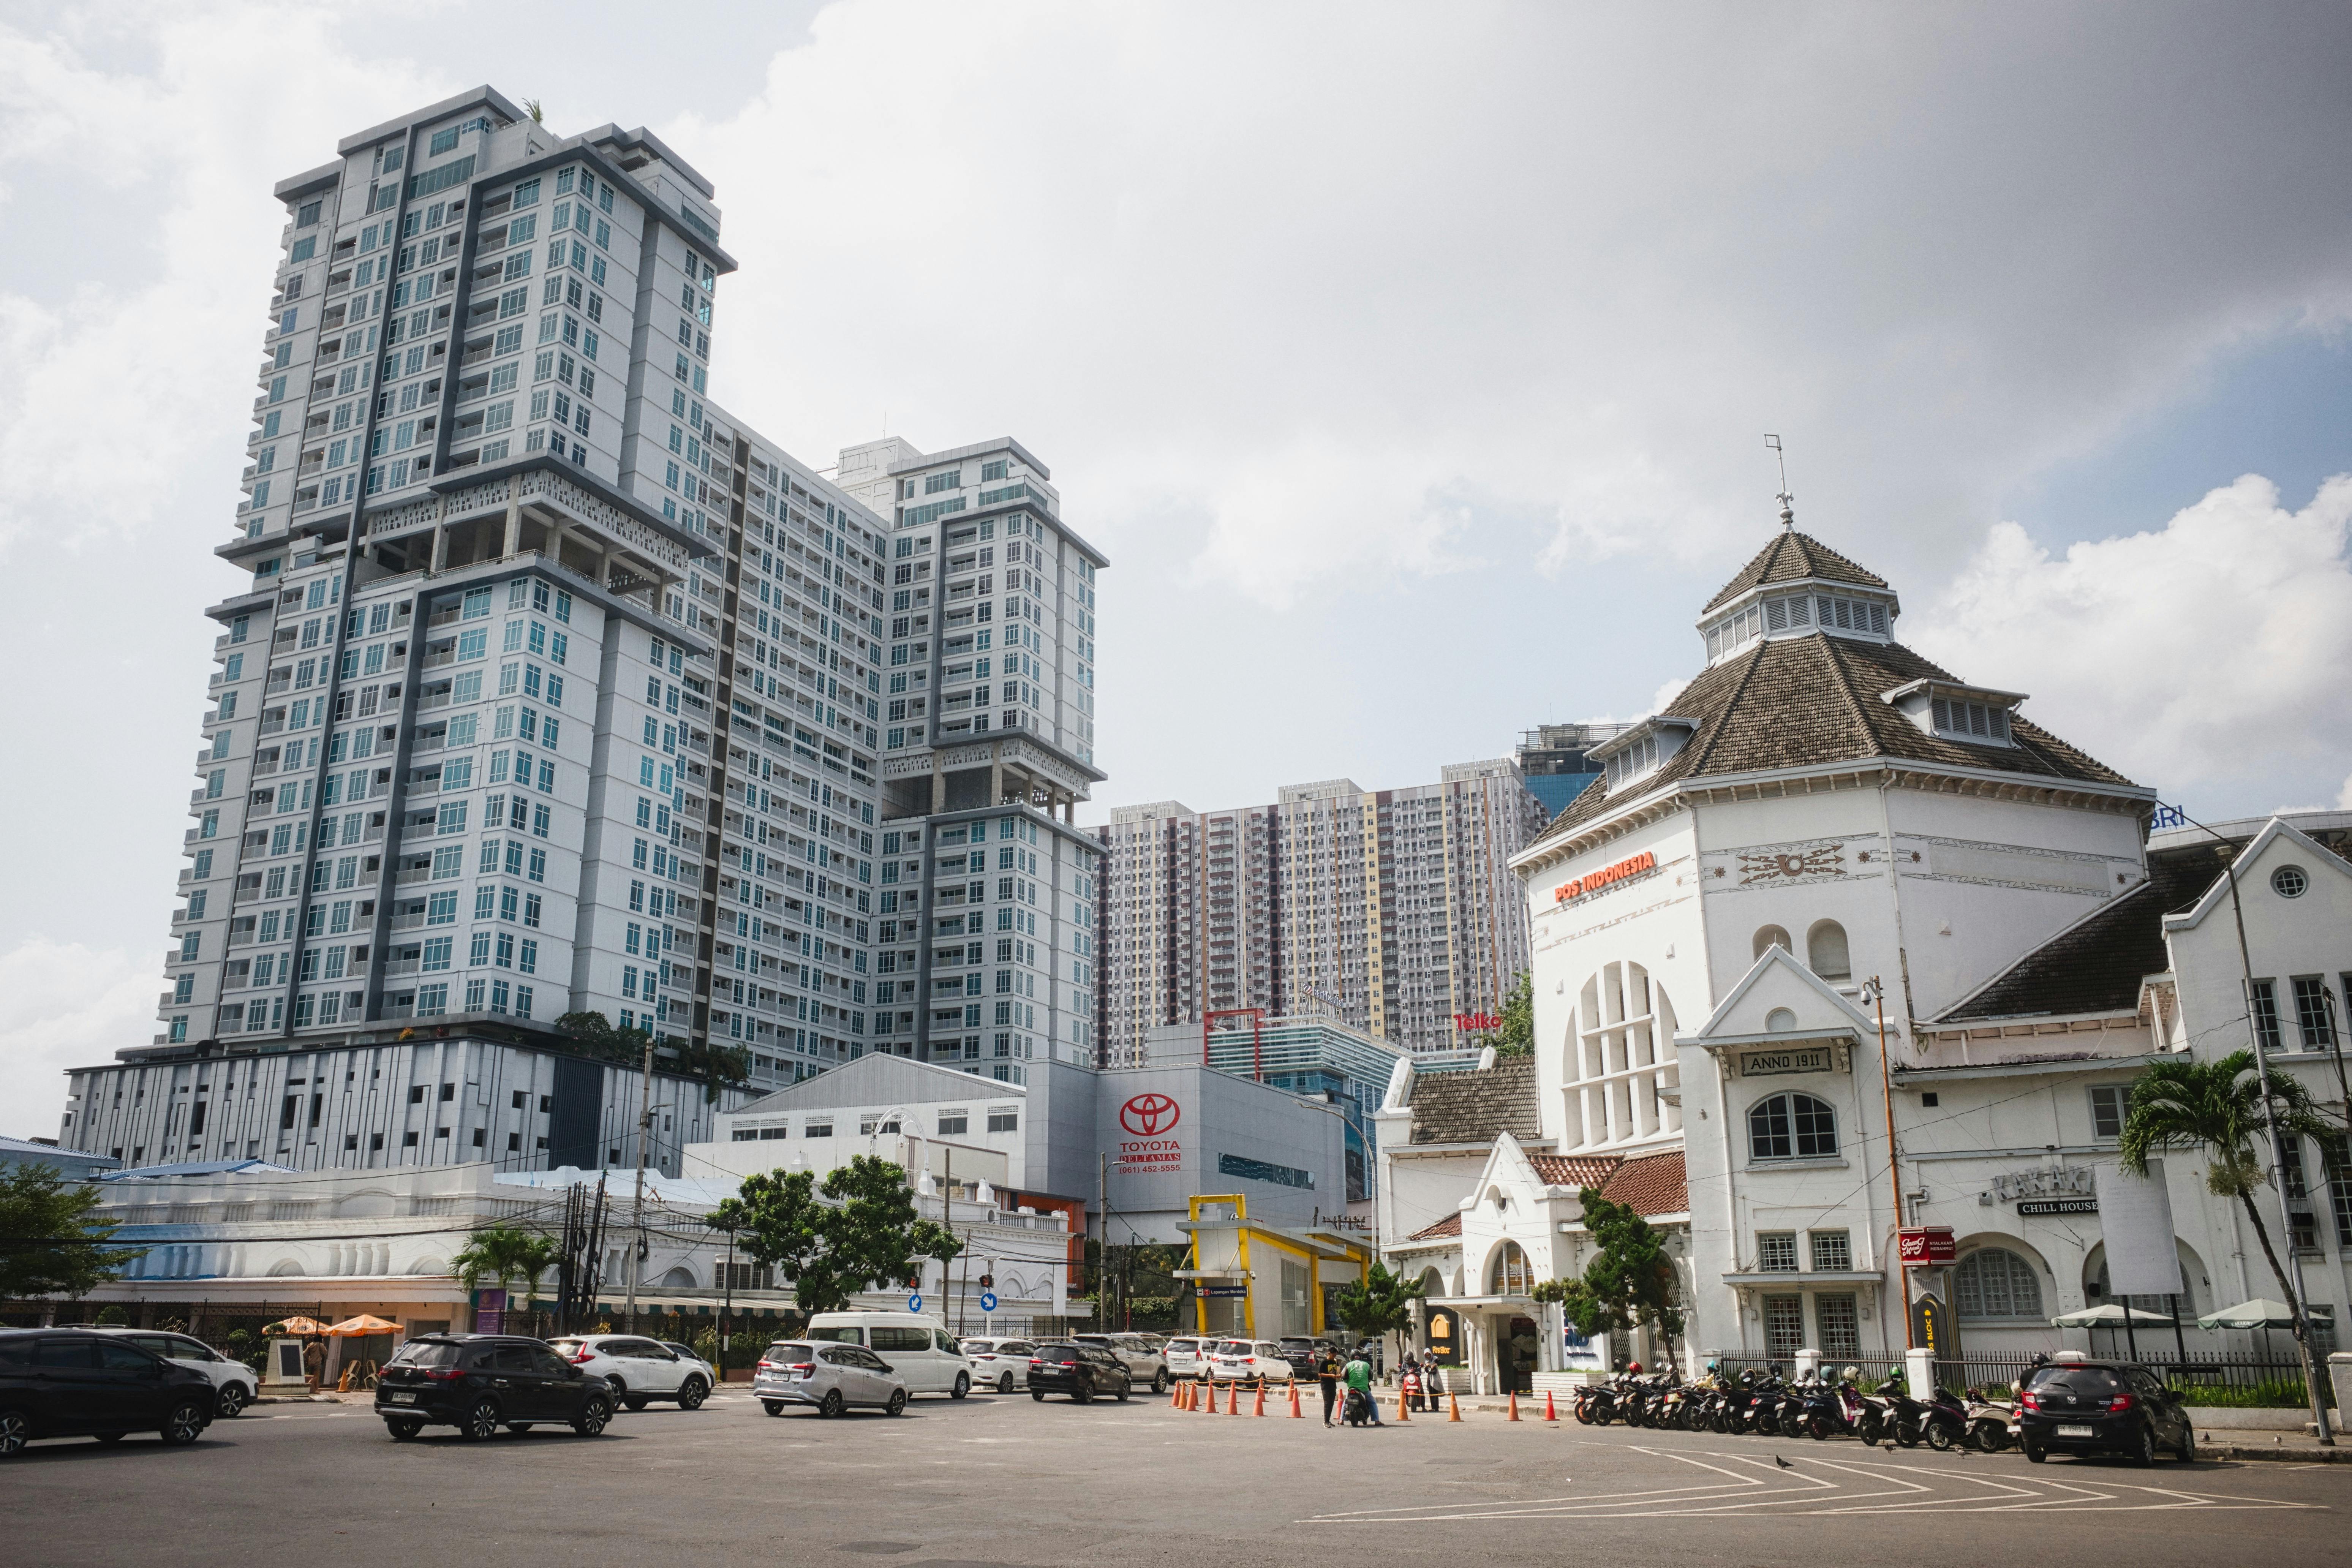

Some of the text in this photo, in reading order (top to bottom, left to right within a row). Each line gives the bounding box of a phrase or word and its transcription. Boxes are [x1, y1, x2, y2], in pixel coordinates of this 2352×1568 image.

[1555, 851, 1656, 903] POS INDONESIA
[1750, 1054, 1819, 1069] ANNO 1911
[1120, 1140, 1181, 1152] TOYOTA
[1121, 1153, 1180, 1163] DELTAMAS
[2022, 1202, 2098, 1213] CHILL HOUSE
